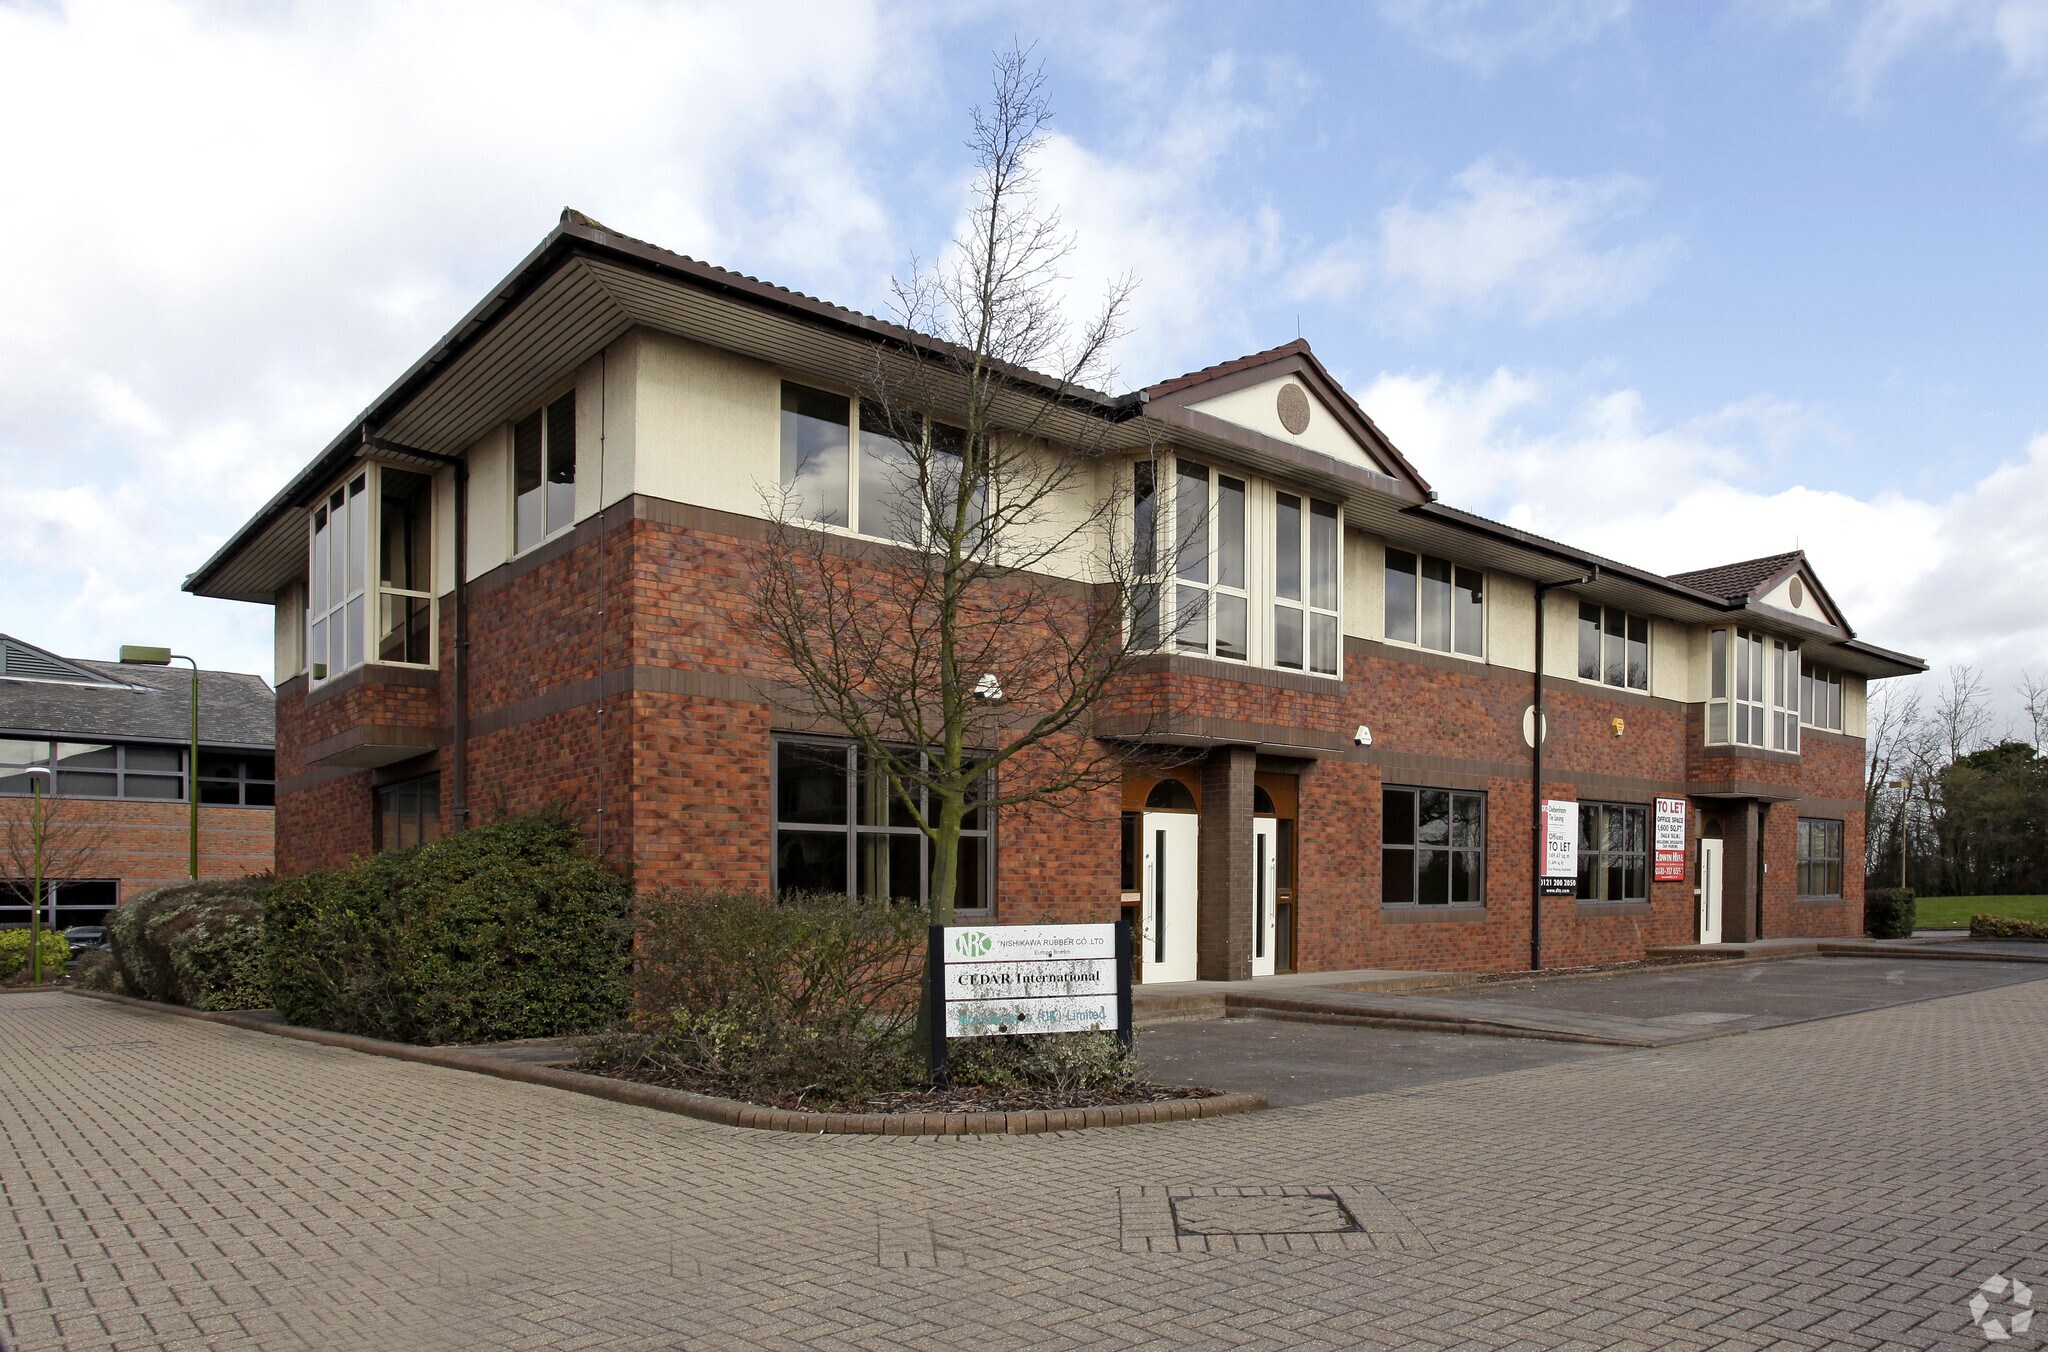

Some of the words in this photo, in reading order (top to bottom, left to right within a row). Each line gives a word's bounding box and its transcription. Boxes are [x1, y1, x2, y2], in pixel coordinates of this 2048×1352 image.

[1657, 801, 1667, 813] TO
[1670, 802, 1684, 813] LET
[1549, 842, 1558, 851] TO
[1560, 842, 1570, 851] LET
[1000, 938, 1042, 948] NISHIKAWA
[1043, 937, 1074, 946] RUBBER
[958, 974, 1010, 986] CEDAR
[1016, 971, 1100, 984] International
[1066, 1006, 1106, 1021] Limited
